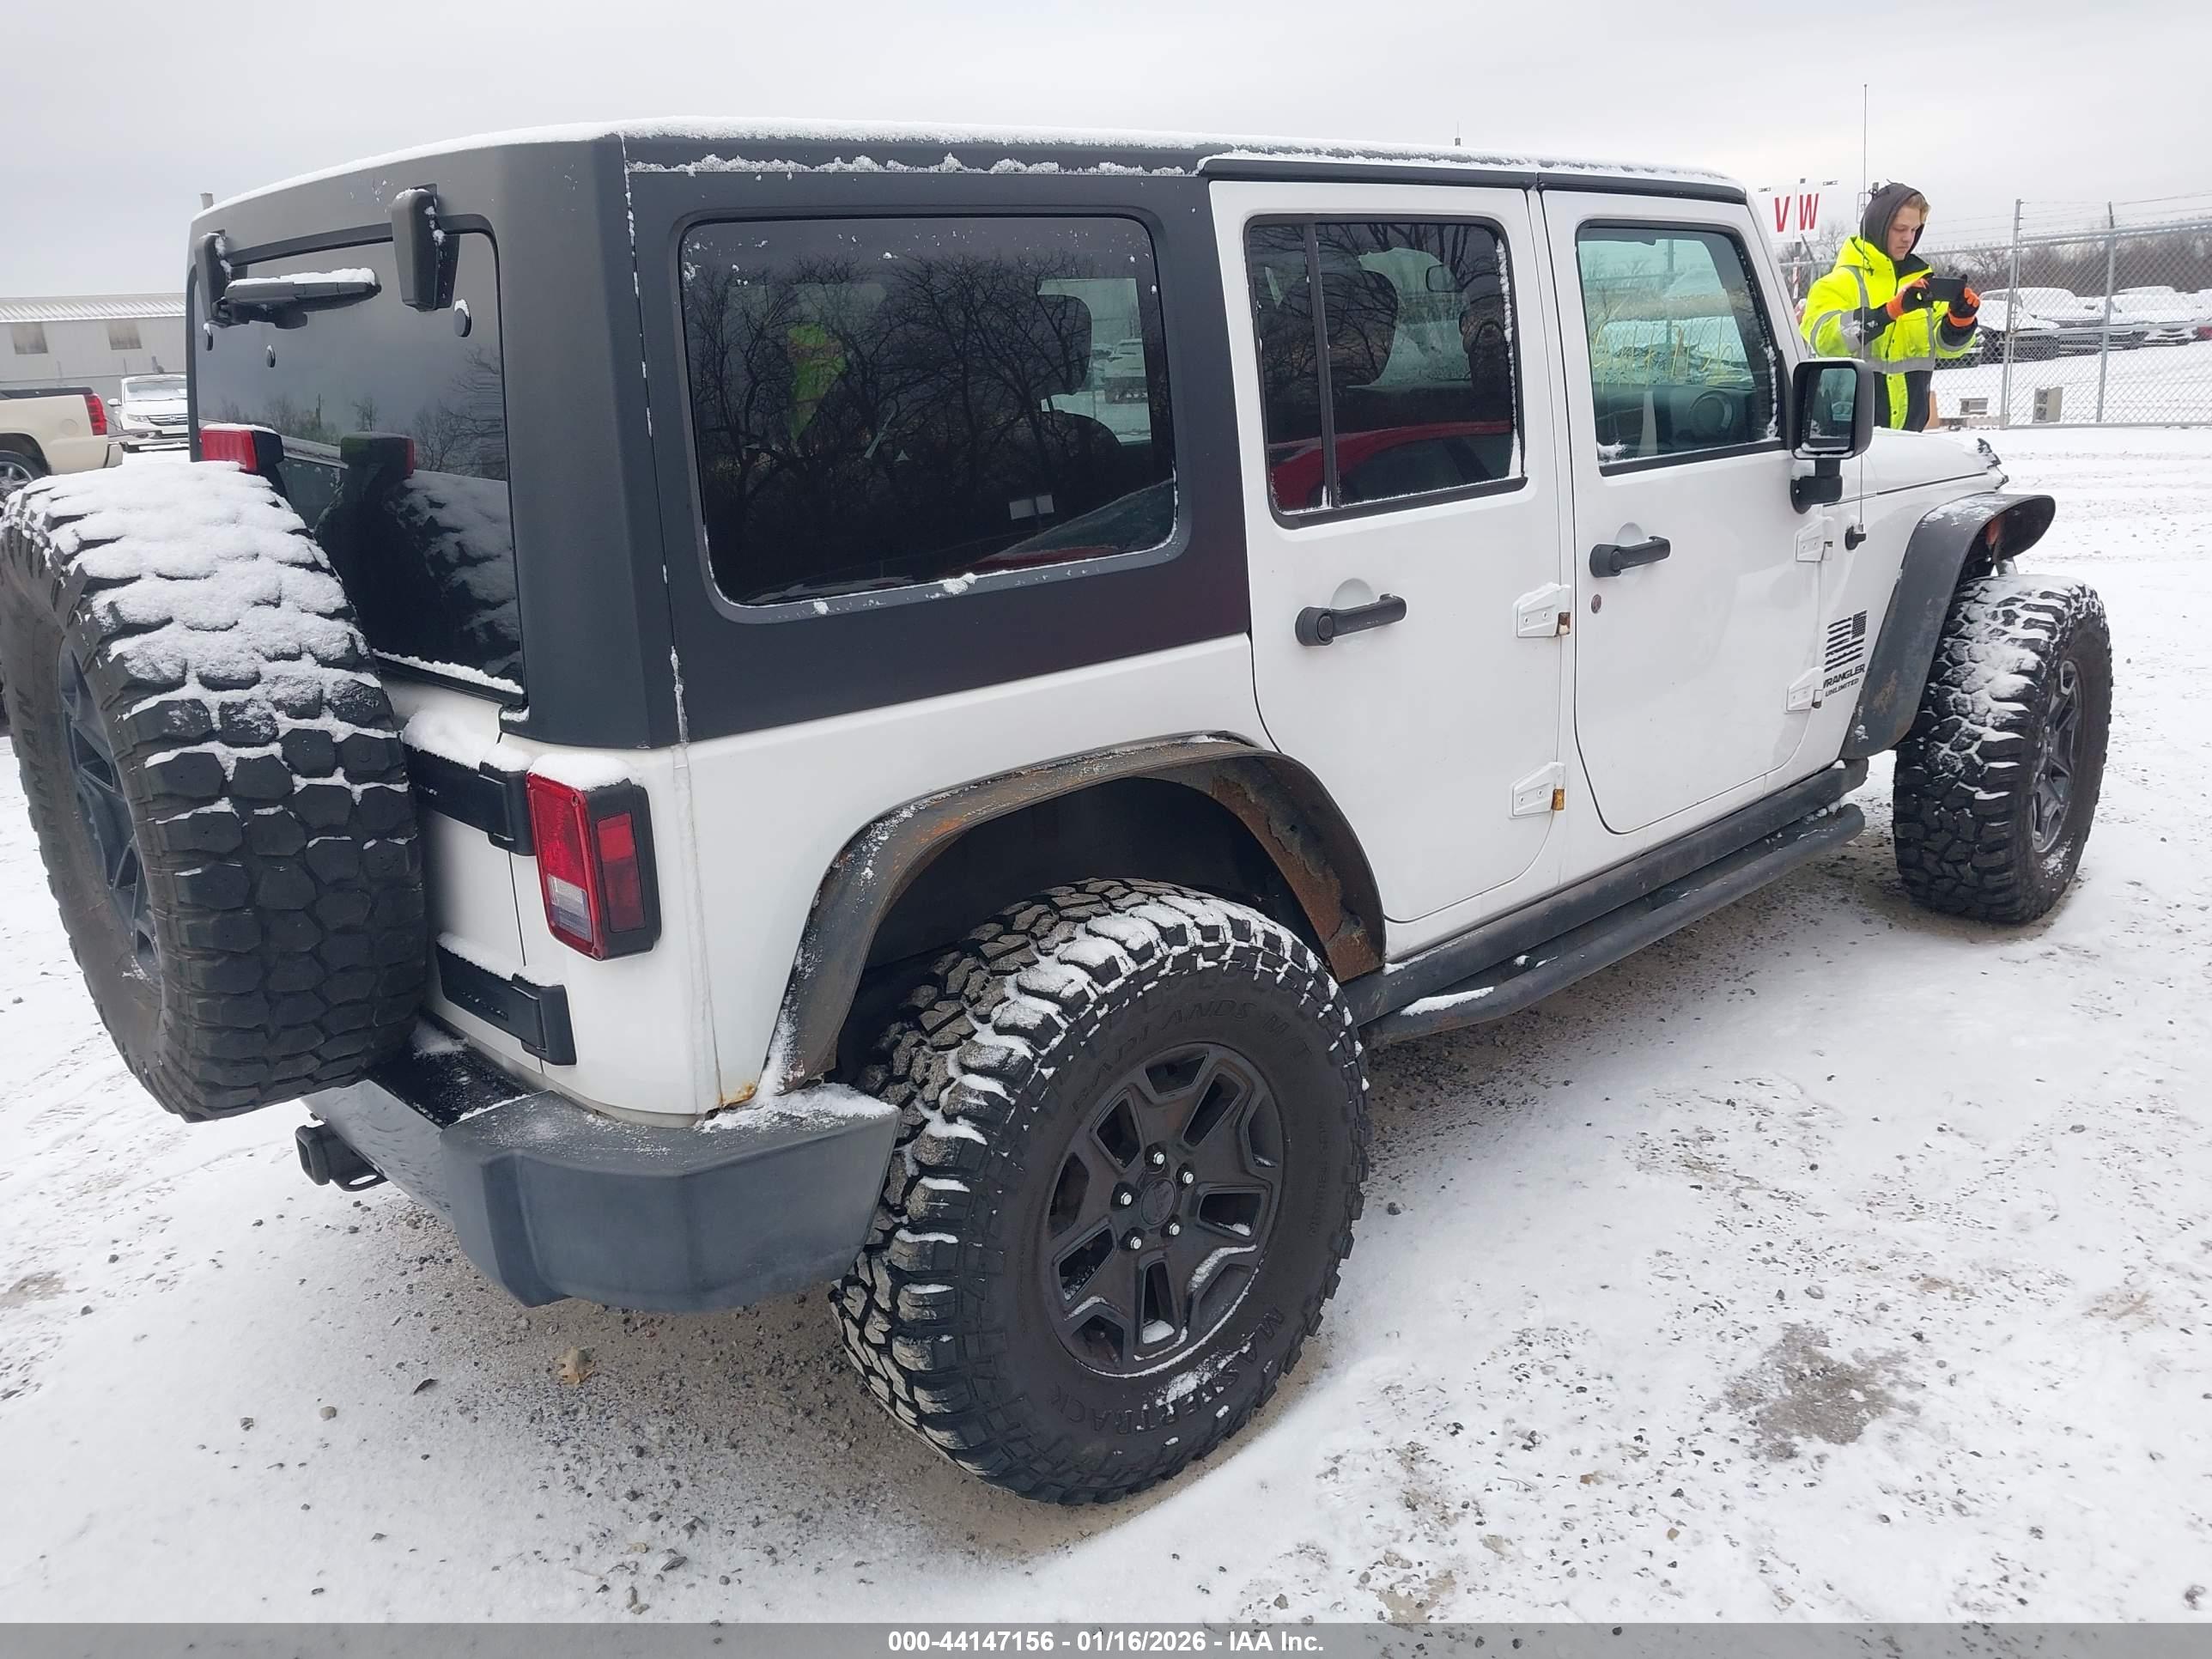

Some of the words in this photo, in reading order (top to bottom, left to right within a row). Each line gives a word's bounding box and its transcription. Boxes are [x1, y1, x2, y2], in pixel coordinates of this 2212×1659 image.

[1774, 196, 1790, 233] V
[1800, 193, 1820, 231] W
[1825, 678, 1860, 697] UNLIMITED
